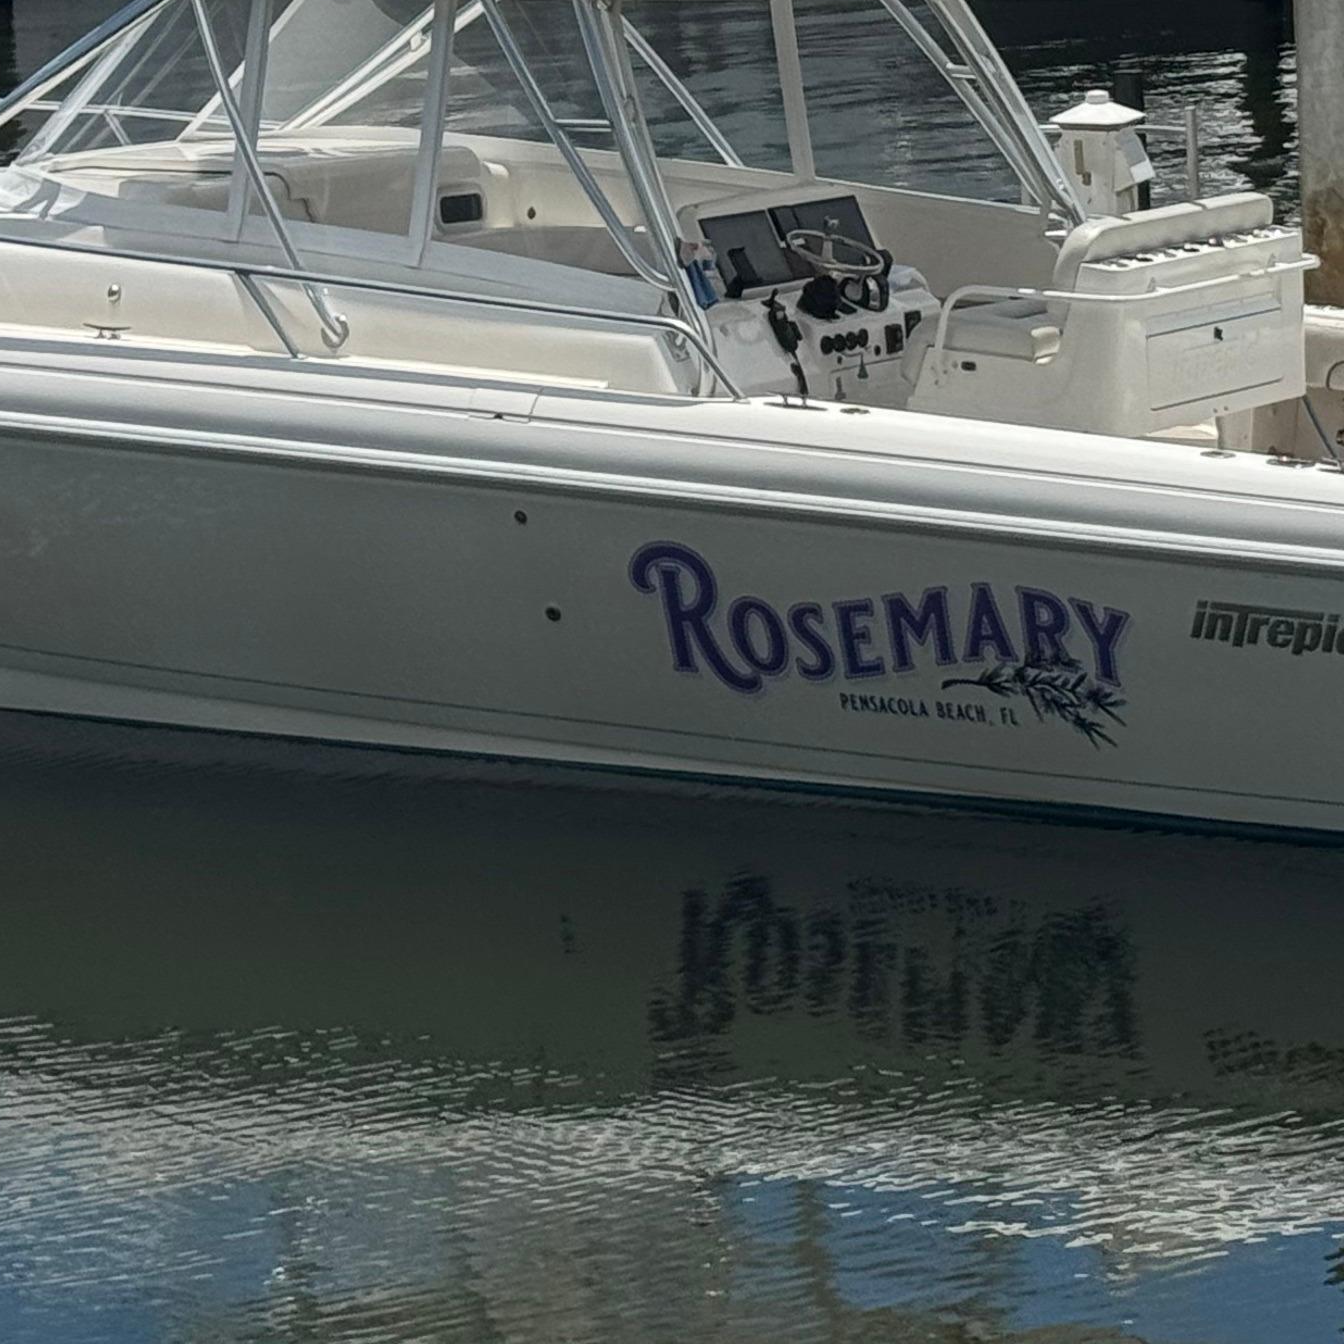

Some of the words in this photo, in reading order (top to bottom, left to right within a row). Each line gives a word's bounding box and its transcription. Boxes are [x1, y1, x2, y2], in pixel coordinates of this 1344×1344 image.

[628, 540, 1131, 694] ROSEMARY
[839, 692, 929, 718] PENSACOLA
[936, 701, 994, 727] BEACH,
[1000, 707, 1022, 726] FL
